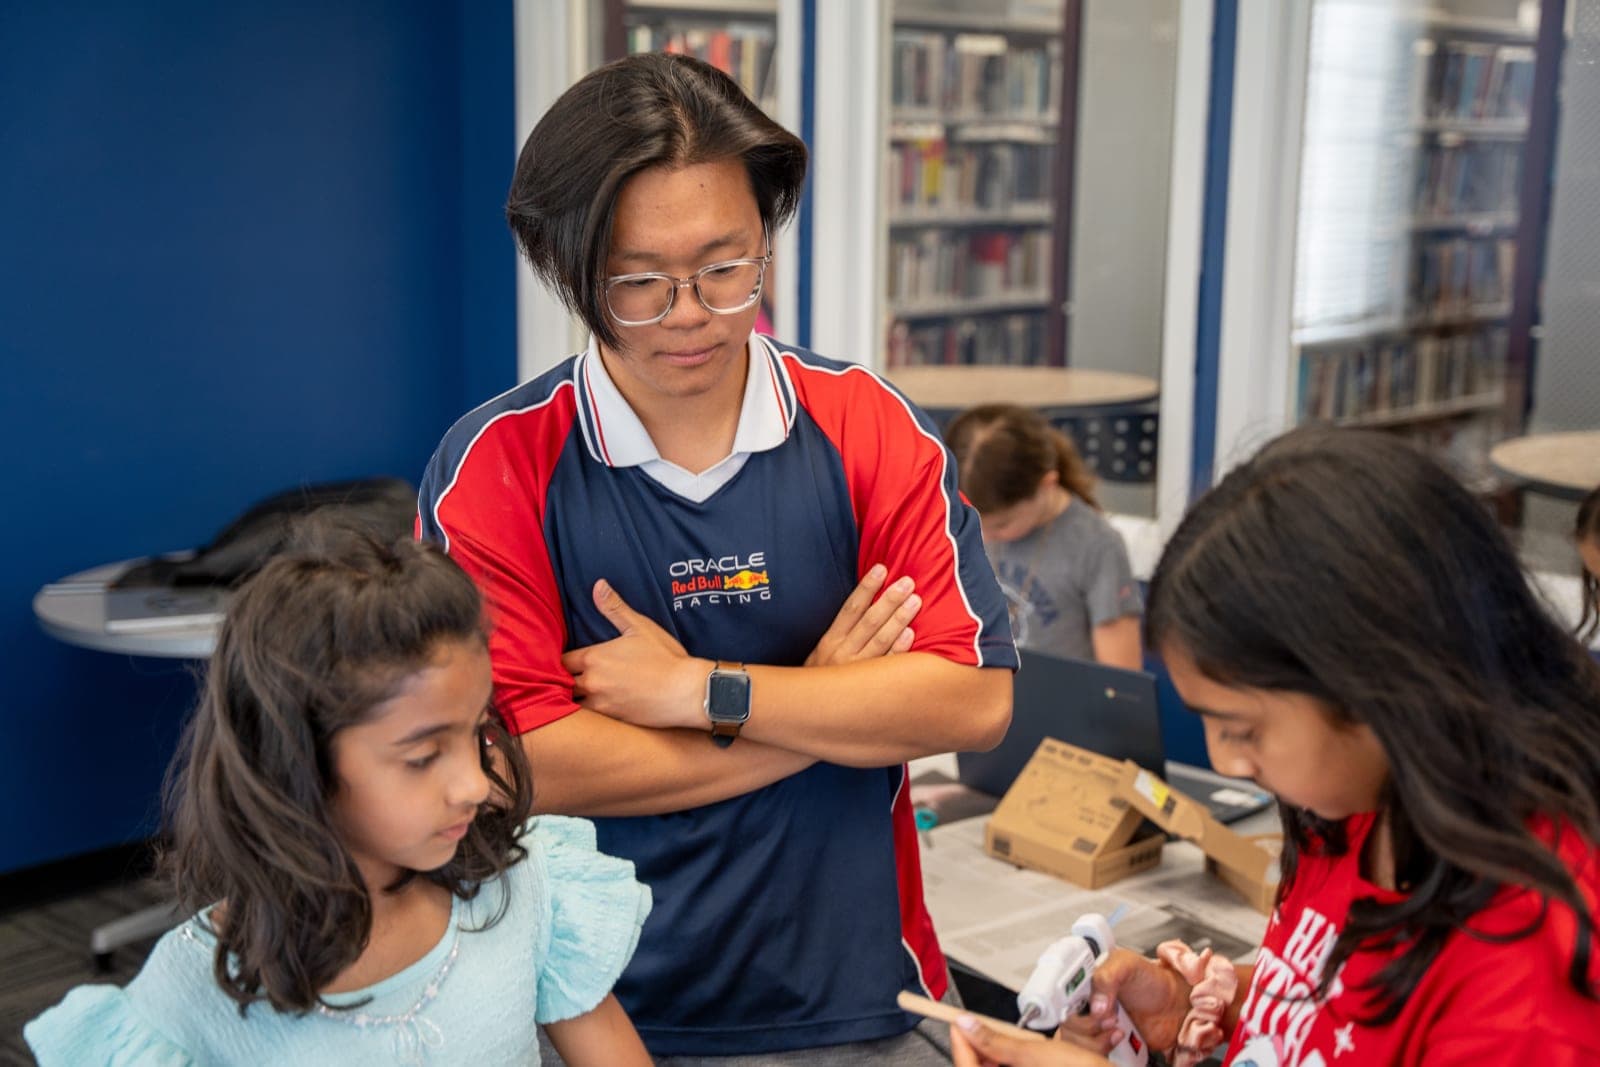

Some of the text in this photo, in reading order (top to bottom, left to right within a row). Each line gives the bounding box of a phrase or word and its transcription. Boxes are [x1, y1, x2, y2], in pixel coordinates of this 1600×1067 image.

[669, 551, 766, 577] ORACLE
[671, 575, 722, 595] Red Bull
[673, 590, 772, 612] RACING
